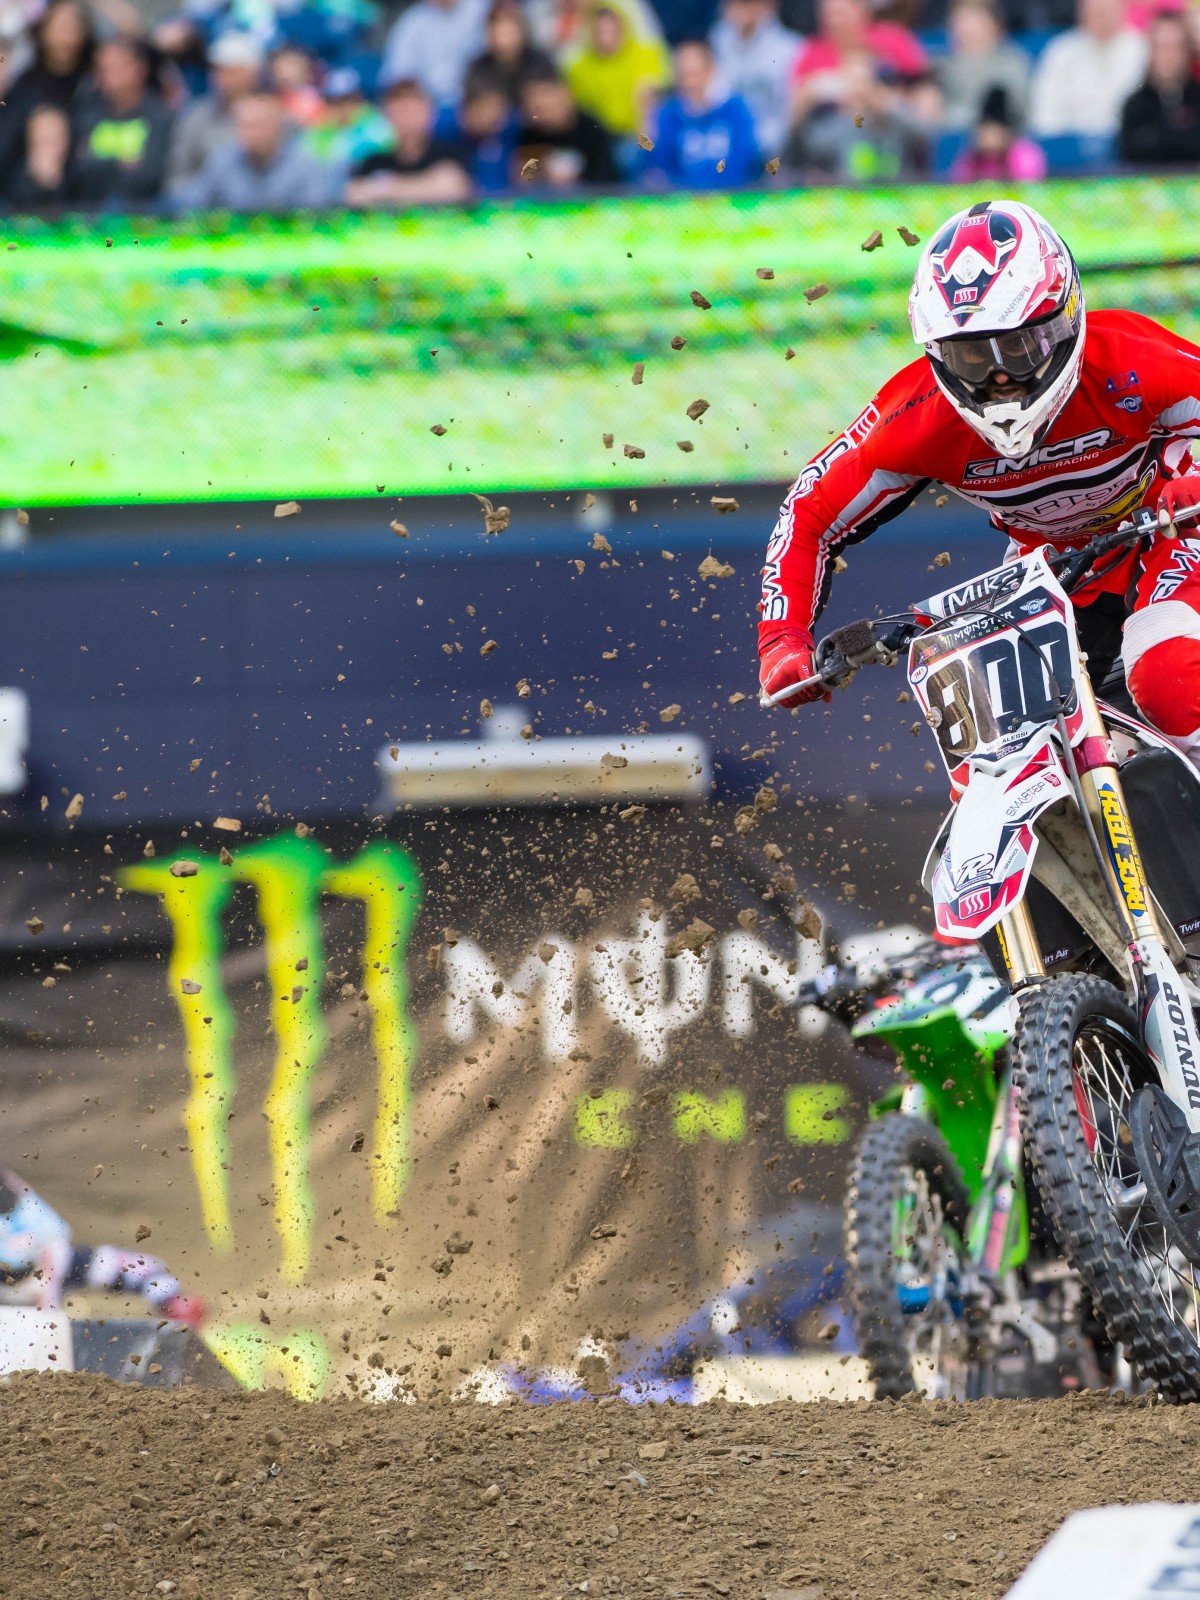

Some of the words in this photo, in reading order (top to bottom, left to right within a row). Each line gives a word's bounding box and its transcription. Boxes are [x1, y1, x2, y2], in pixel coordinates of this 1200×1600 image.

[884, 386, 941, 427] DUNLO
[1097, 789, 1131, 849] TECH
[1114, 852, 1148, 911] RACE
[573, 1082, 852, 1149] ENE
